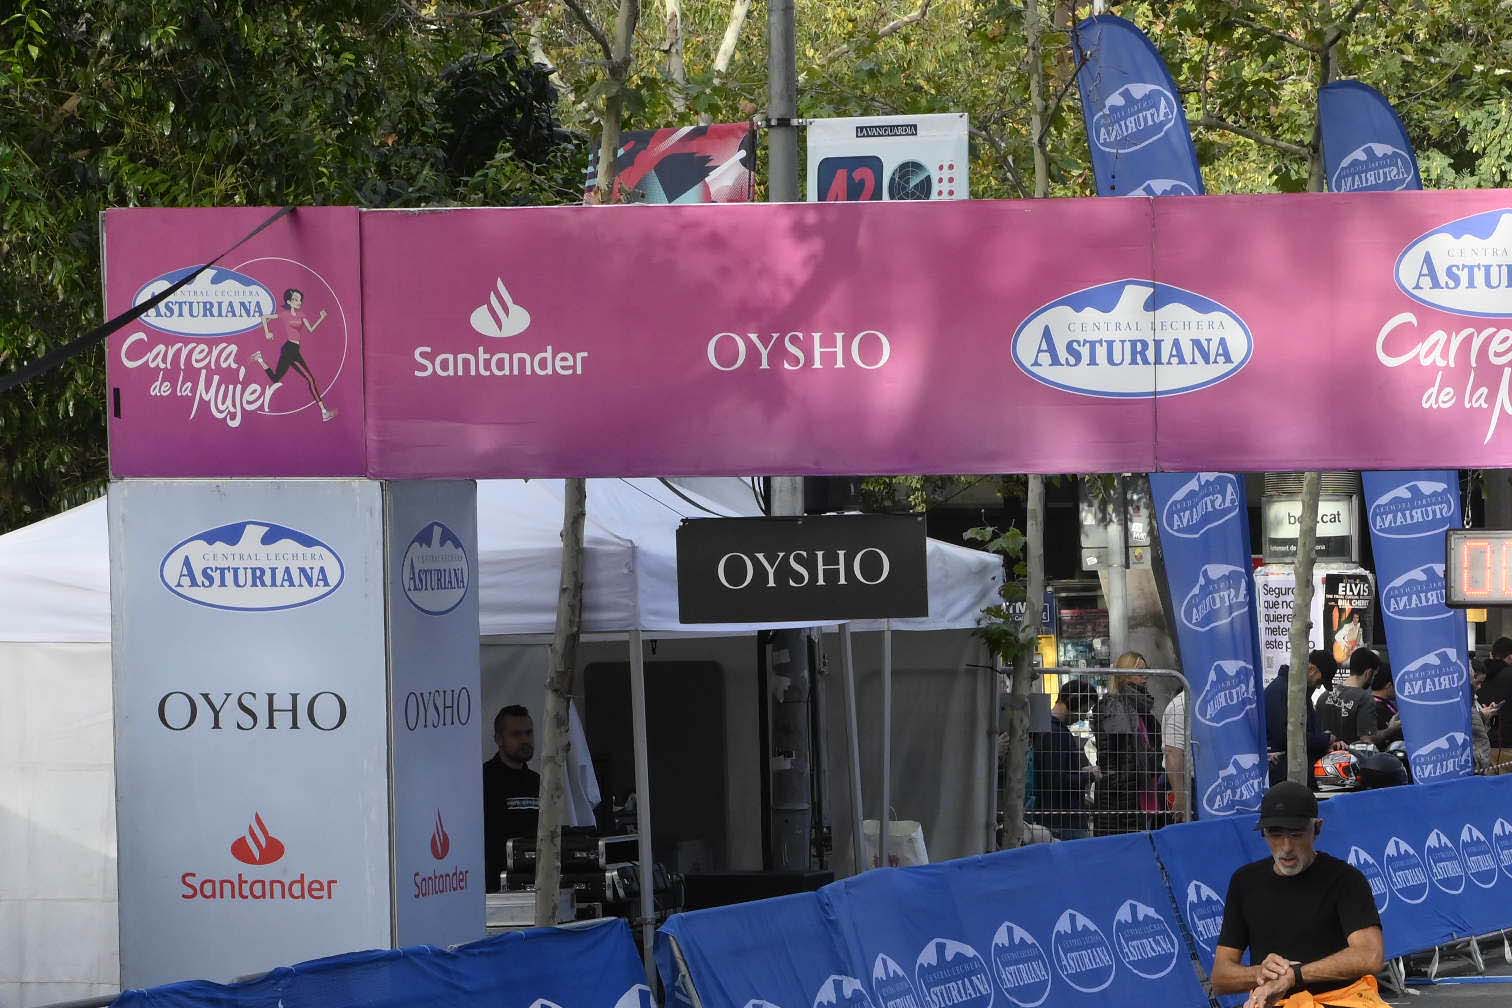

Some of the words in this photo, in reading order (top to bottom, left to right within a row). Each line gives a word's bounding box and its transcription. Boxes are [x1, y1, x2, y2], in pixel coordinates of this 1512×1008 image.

[857, 126, 867, 137] LA
[868, 124, 917, 136] VANGUARDIA
[1068, 319, 1143, 332] CENTRAL
[1152, 319, 1227, 332] LECHERA
[120, 332, 241, 370] Carrera
[413, 346, 589, 378] Santander
[706, 329, 892, 372] OYSHO
[1030, 323, 1235, 369] ASTURIANA
[149, 370, 173, 397] de
[176, 376, 194, 397] la
[190, 366, 283, 428] Mujer
[1421, 371, 1455, 410] de
[1464, 372, 1489, 410] la
[175, 554, 331, 589] ASTURIANA
[202, 552, 261, 562] CENTRAL
[266, 551, 325, 562] LECHERA
[407, 553, 465, 592] ASTURIANA
[717, 547, 890, 590] OYSHO
[1263, 600, 1281, 612] que
[1338, 582, 1369, 596] ELVIS
[1265, 640, 1284, 650] este
[157, 691, 348, 732] OYSHO
[404, 686, 472, 732] OYSHO
[180, 872, 338, 901] Santander
[413, 867, 469, 900] Santander
[1058, 943, 1114, 976] ASTURIANA
